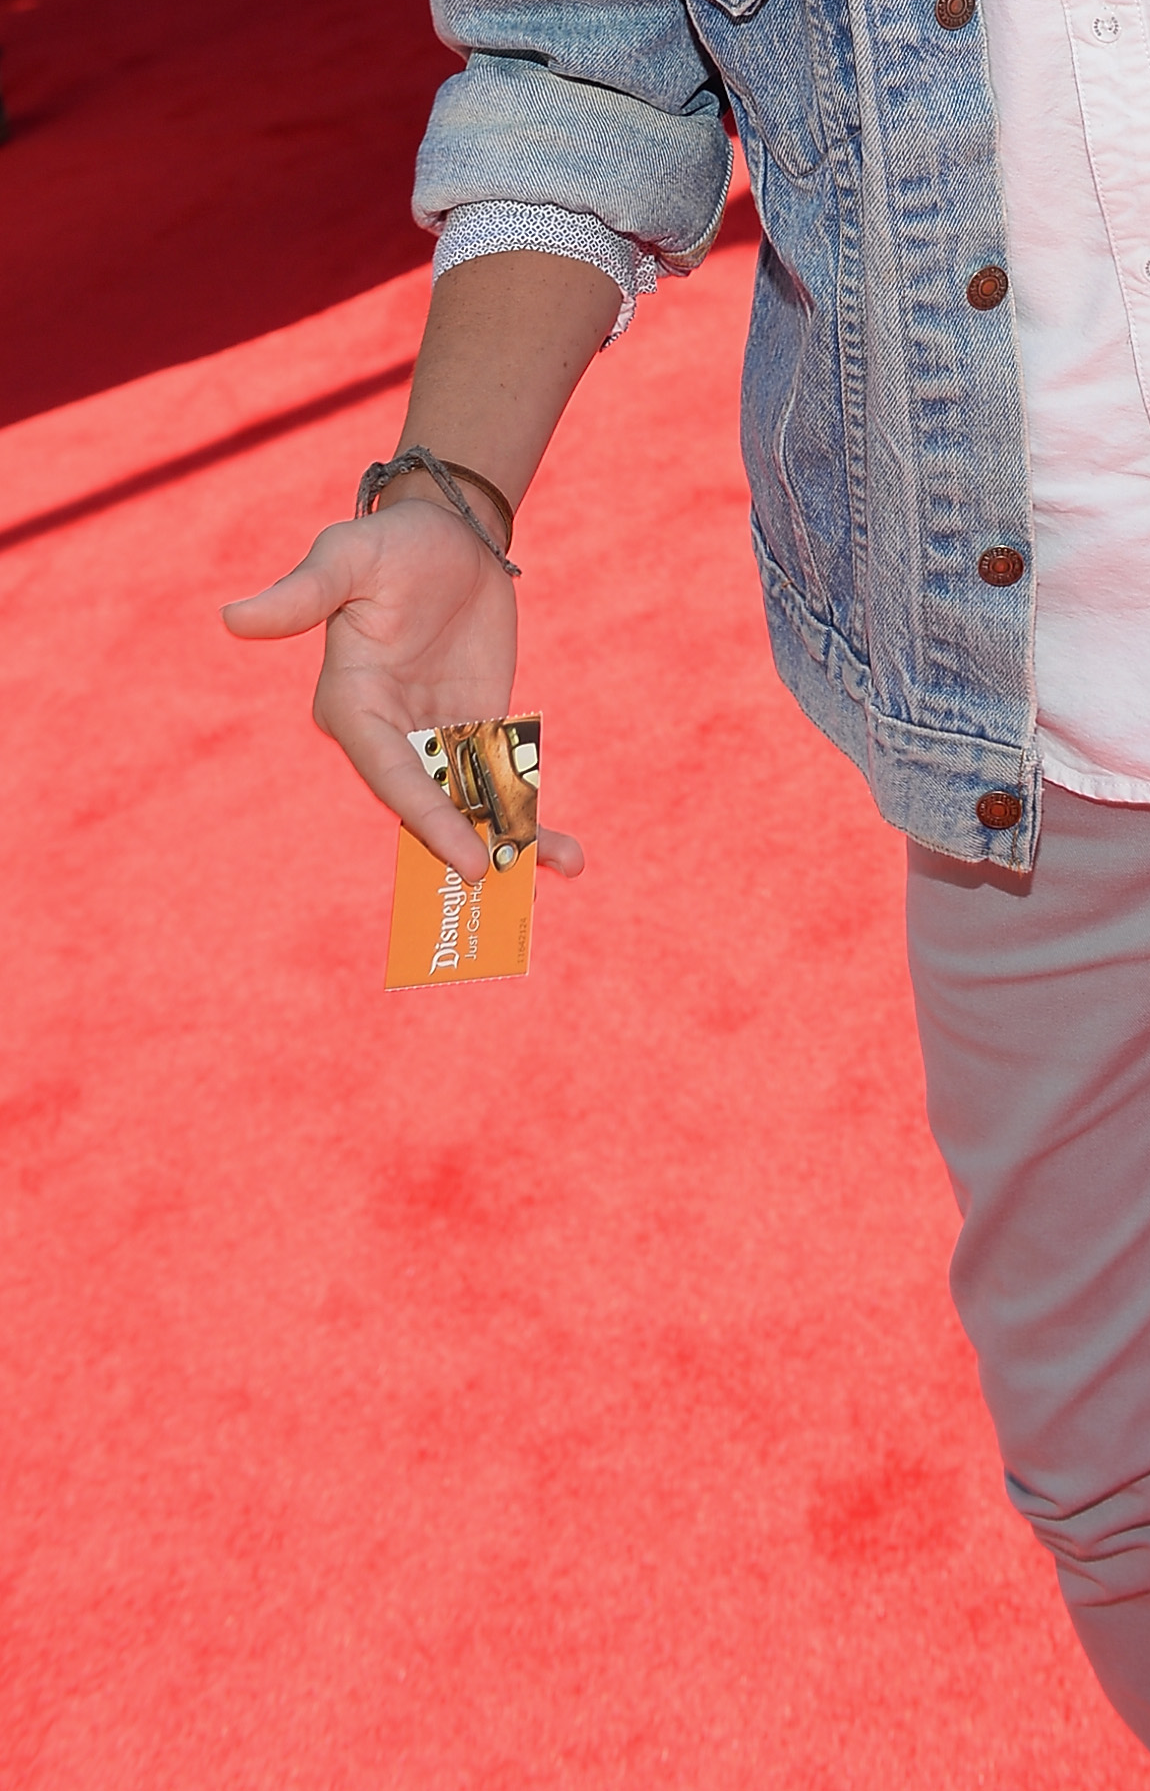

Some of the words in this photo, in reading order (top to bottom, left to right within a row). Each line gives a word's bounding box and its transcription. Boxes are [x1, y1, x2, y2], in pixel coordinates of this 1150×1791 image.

[470, 878, 487, 903] Ha
[429, 865, 467, 976] Disneyla
[466, 906, 480, 932] Got
[465, 934, 478, 960] Just
